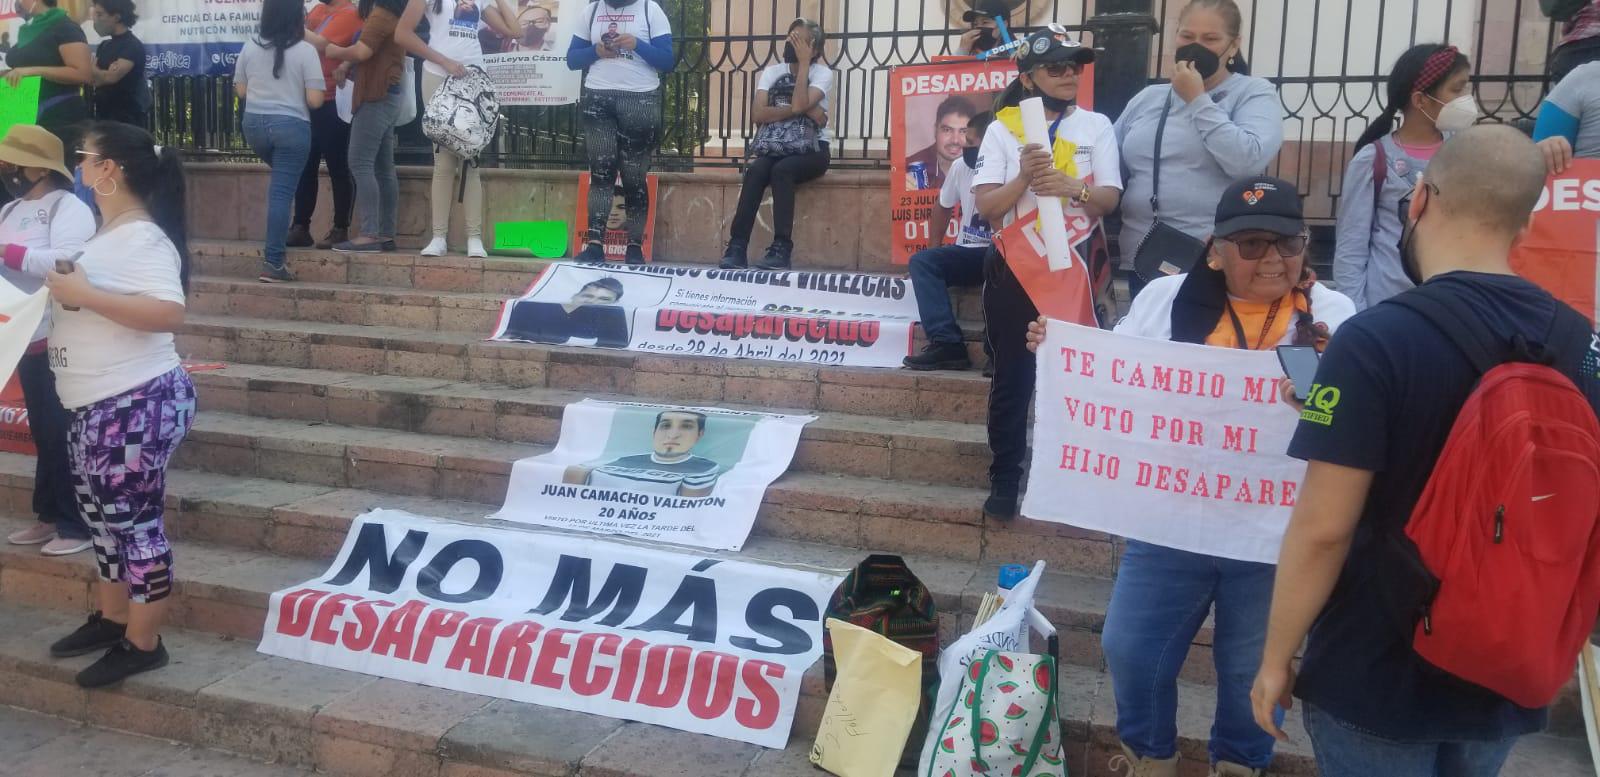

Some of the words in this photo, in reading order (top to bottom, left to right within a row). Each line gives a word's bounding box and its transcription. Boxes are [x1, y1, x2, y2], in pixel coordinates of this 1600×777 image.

[214, 13, 227, 21] LA
[501, 54, 530, 63] Leyva
[901, 197, 912, 206] 23
[914, 195, 938, 206] JULI
[892, 209, 912, 221] LUIS
[797, 272, 906, 300] VILLEZCAS
[675, 288, 685, 298] Si
[686, 289, 710, 302] tienes
[711, 291, 757, 307] información
[638, 341, 684, 352] desde
[709, 342, 728, 355] de
[733, 342, 774, 358] Abril
[1060, 347, 1096, 377] TE
[1111, 358, 1226, 398] CAMBIO
[1243, 376, 1281, 404] MI
[1063, 397, 1134, 434] VOTO
[1150, 414, 1204, 446] POR
[1222, 425, 1259, 453] MI
[1059, 444, 1121, 480] HIJO
[541, 484, 578, 499] JUAN
[580, 487, 649, 506] CAMACHO
[598, 507, 615, 518] 20
[617, 507, 657, 521] AÑOS
[650, 524, 679, 532] TARDE
[325, 522, 504, 604] NO
[526, 554, 821, 656] MÁS
[276, 588, 786, 730] DESAPARECIDOS
